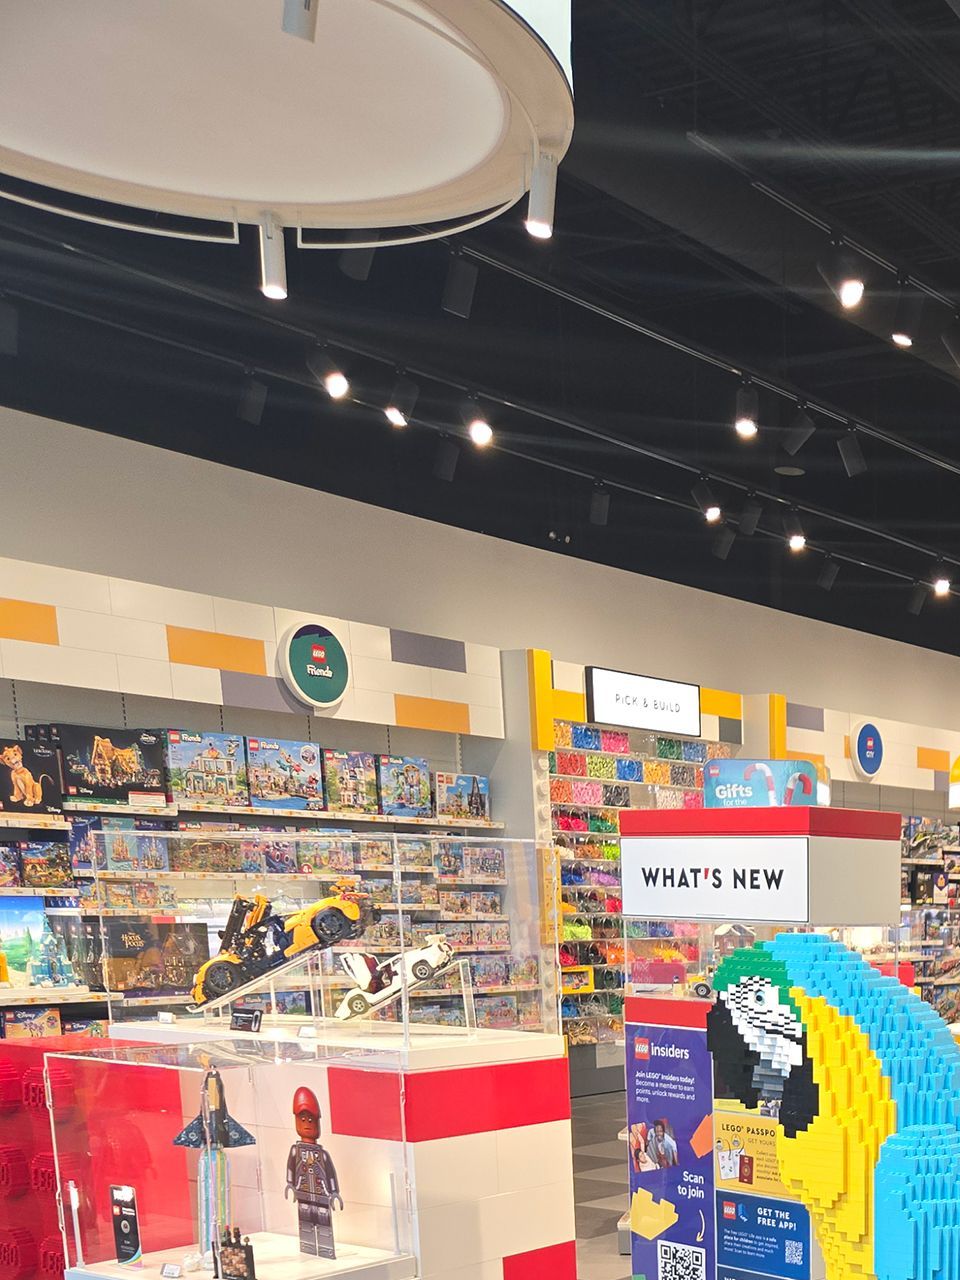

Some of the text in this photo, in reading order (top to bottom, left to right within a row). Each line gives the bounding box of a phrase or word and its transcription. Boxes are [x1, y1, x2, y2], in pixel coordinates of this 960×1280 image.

[306, 664, 333, 678] Friends
[715, 783, 753, 798] Gifts
[641, 867, 784, 890] WHAT'S NEW
[683, 1171, 704, 1185] Scan
[678, 1184, 704, 1199] to join
[757, 1207, 790, 1220] GET THE
[757, 1217, 776, 1227] FREE
[778, 1221, 797, 1231] APP!
